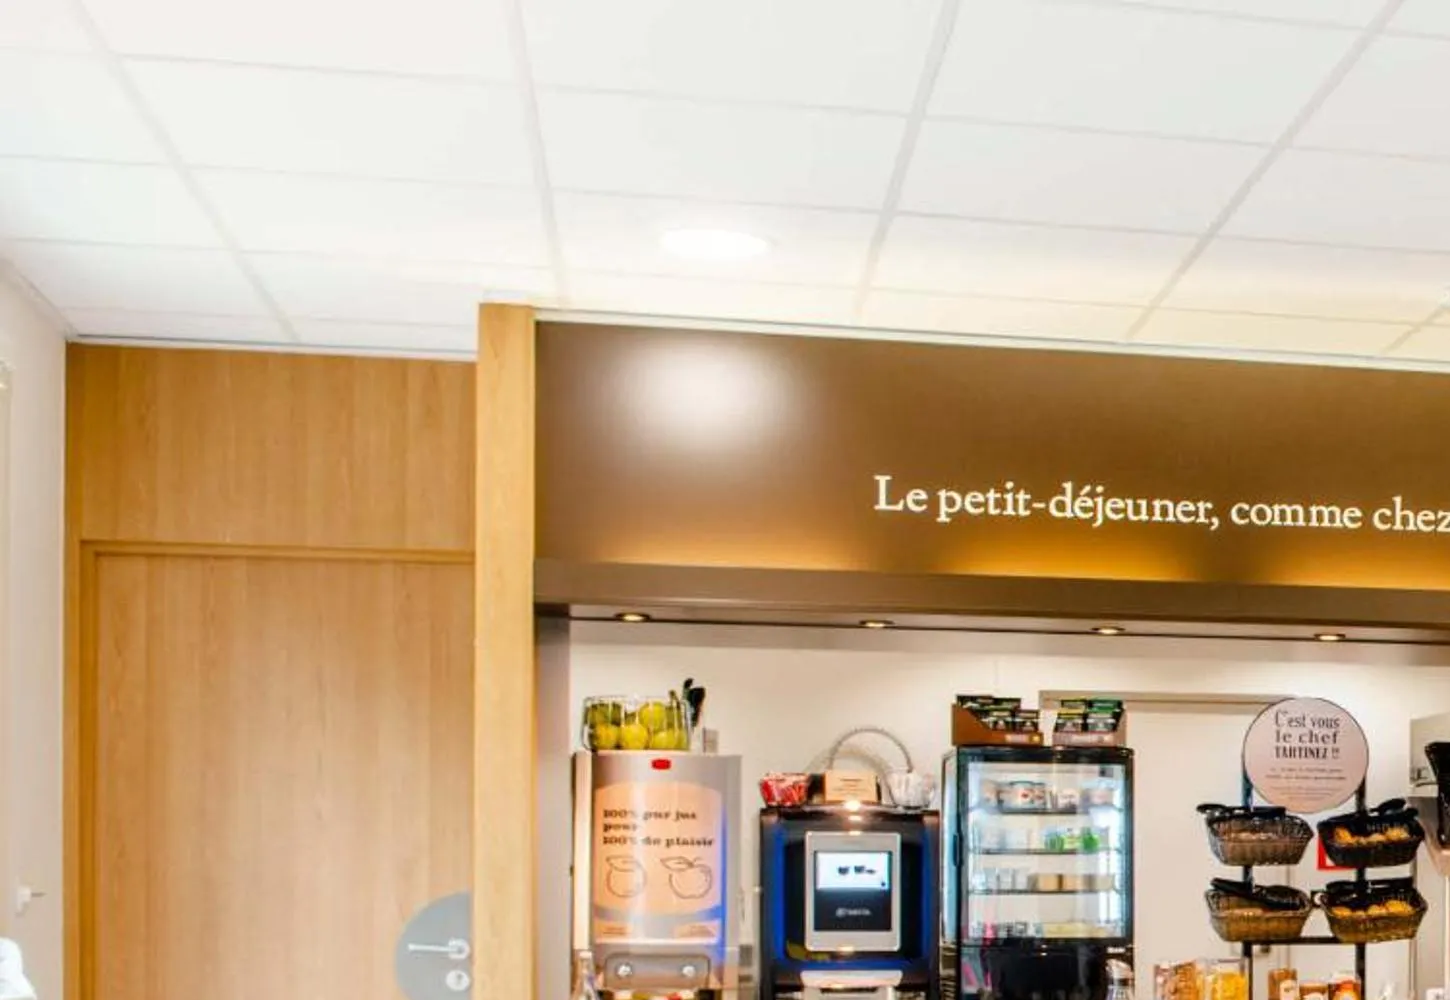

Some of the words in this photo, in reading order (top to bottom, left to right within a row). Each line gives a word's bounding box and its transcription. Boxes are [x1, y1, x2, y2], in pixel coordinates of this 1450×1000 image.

[873, 474, 930, 513] Le
[936, 480, 1220, 531] petit-déjeuner,
[1230, 501, 1363, 529] comme
[1310, 716, 1340, 729] vous
[1275, 729, 1293, 743] le
[1298, 729, 1339, 744] chef
